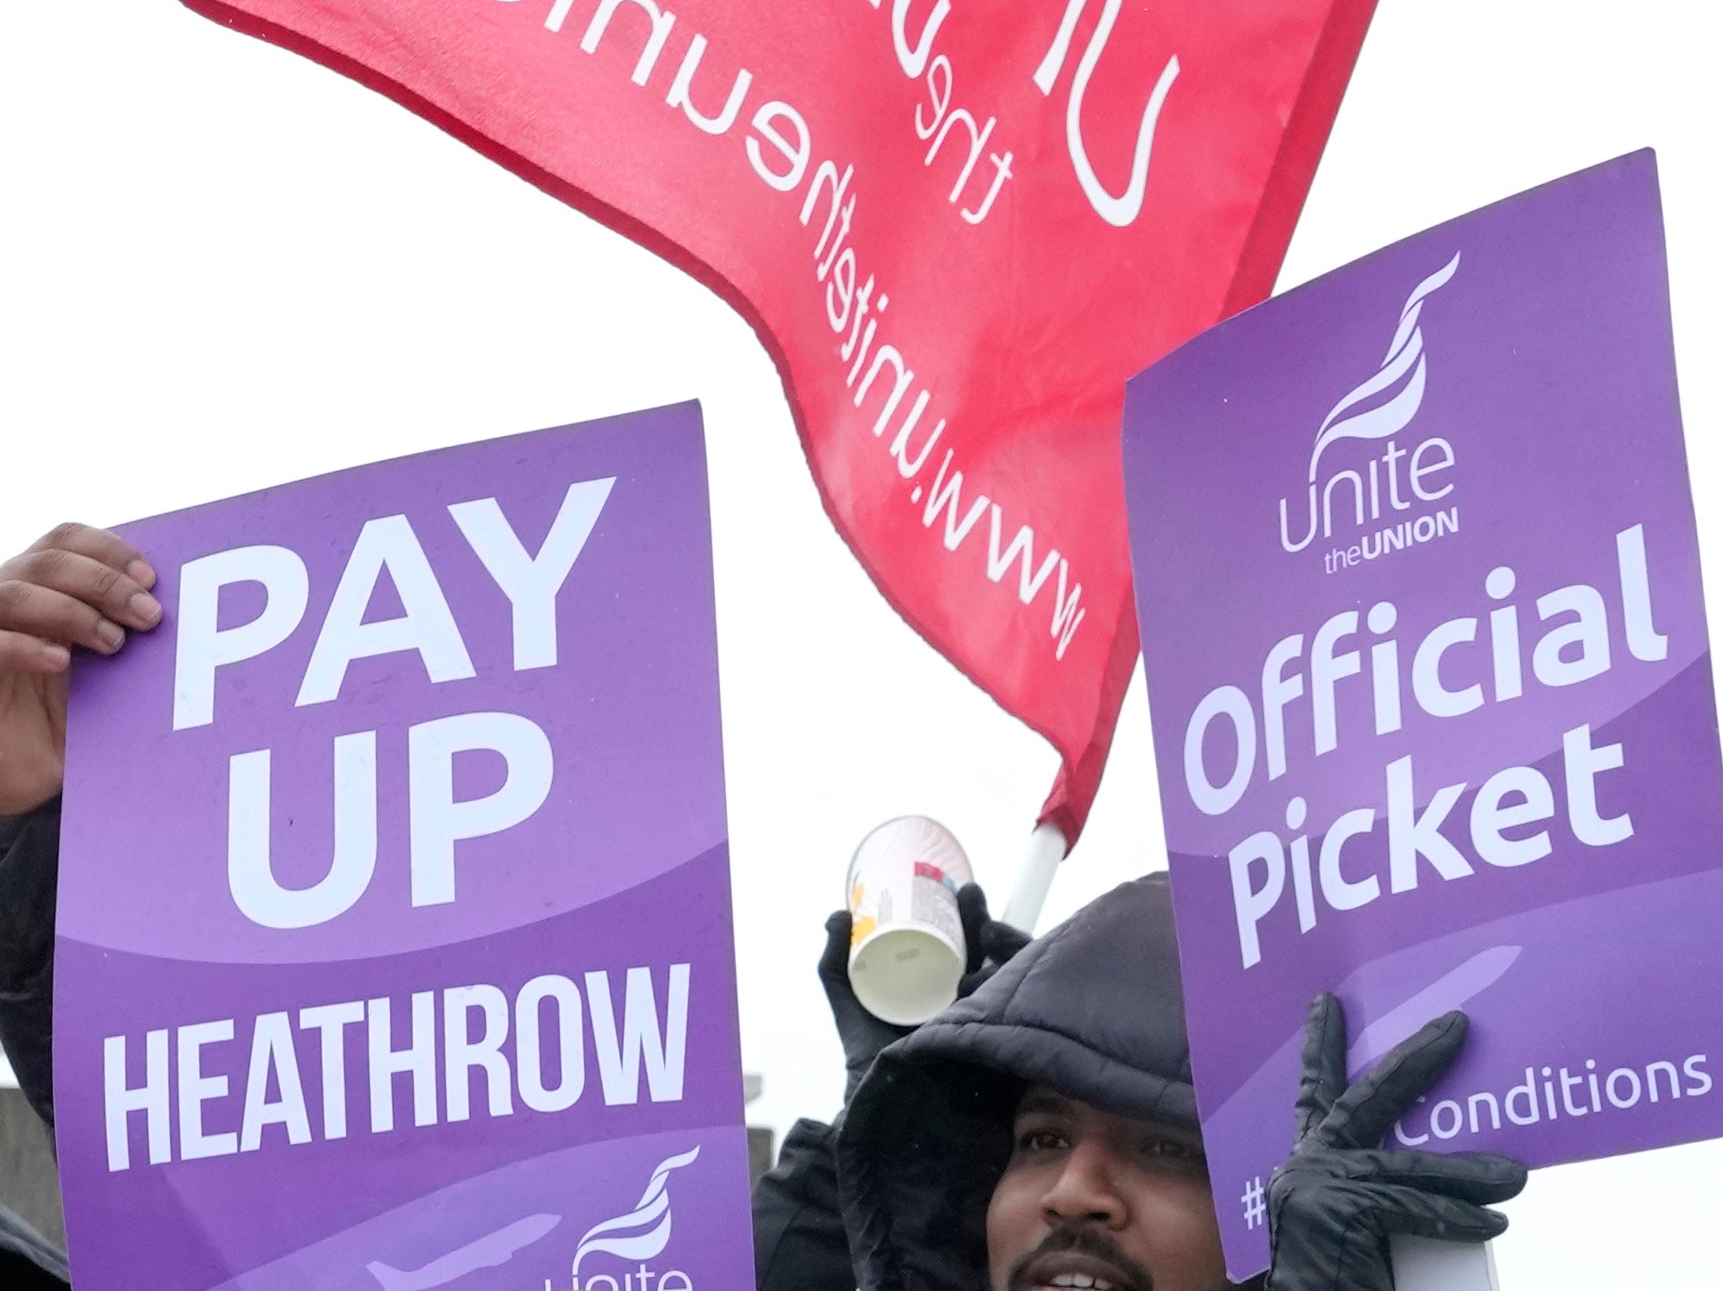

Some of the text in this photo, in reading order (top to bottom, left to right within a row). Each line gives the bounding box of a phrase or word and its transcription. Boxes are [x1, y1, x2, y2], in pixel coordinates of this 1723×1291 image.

[172, 476, 617, 730] PAY
[1323, 506, 1459, 574] theUNION
[1183, 523, 1668, 815] Official
[227, 712, 554, 929] UP
[1227, 722, 1633, 969] Picket
[103, 963, 691, 1171] HEATHROW
